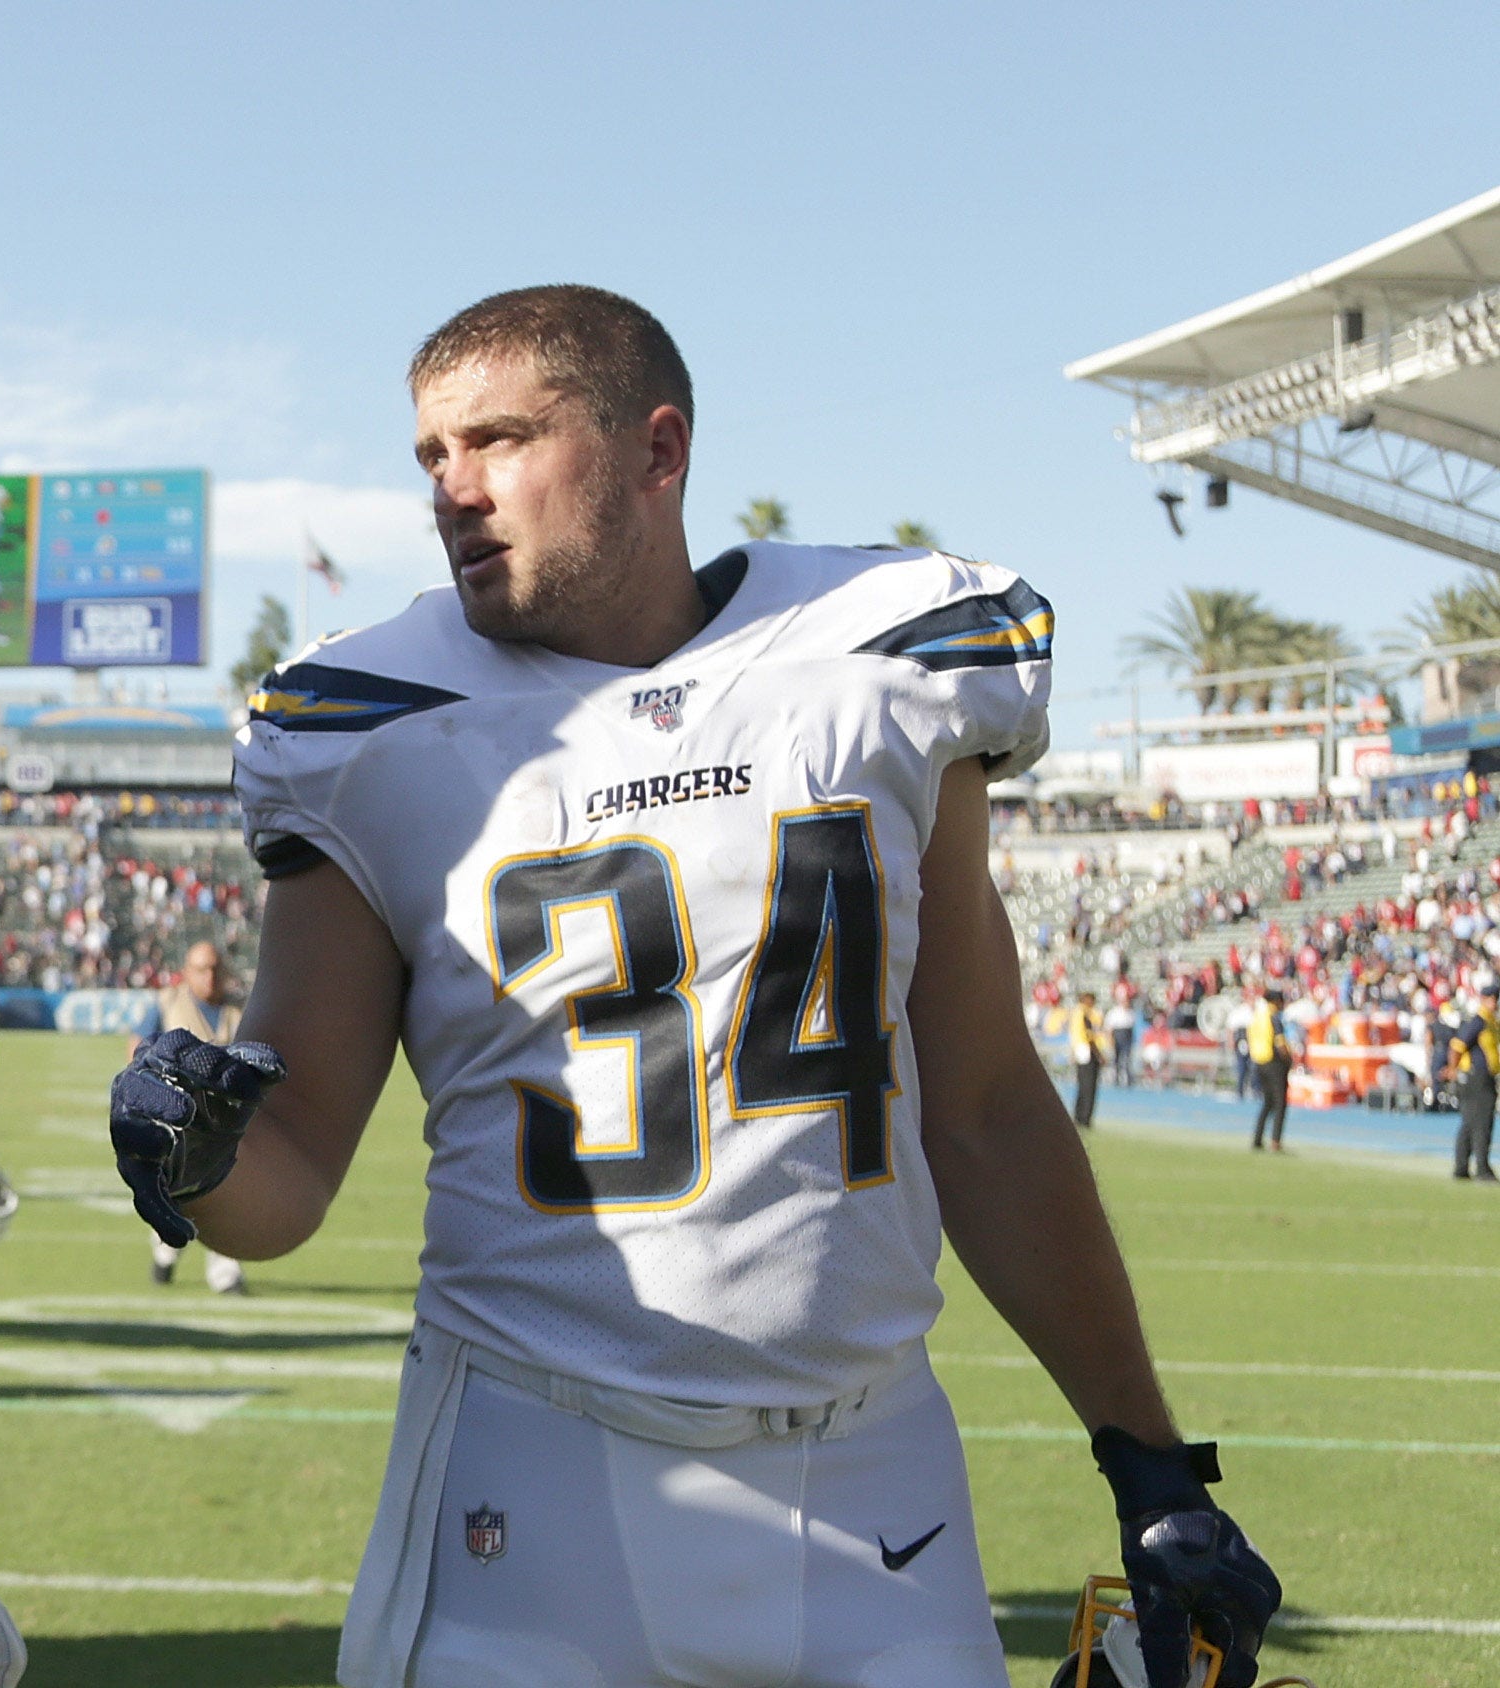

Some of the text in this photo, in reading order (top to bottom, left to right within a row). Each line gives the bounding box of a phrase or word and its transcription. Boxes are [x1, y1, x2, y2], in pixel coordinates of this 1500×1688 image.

[586, 764, 752, 822] CHARGERS
[482, 801, 903, 1216] 34
[470, 1530, 500, 1552] NFL
